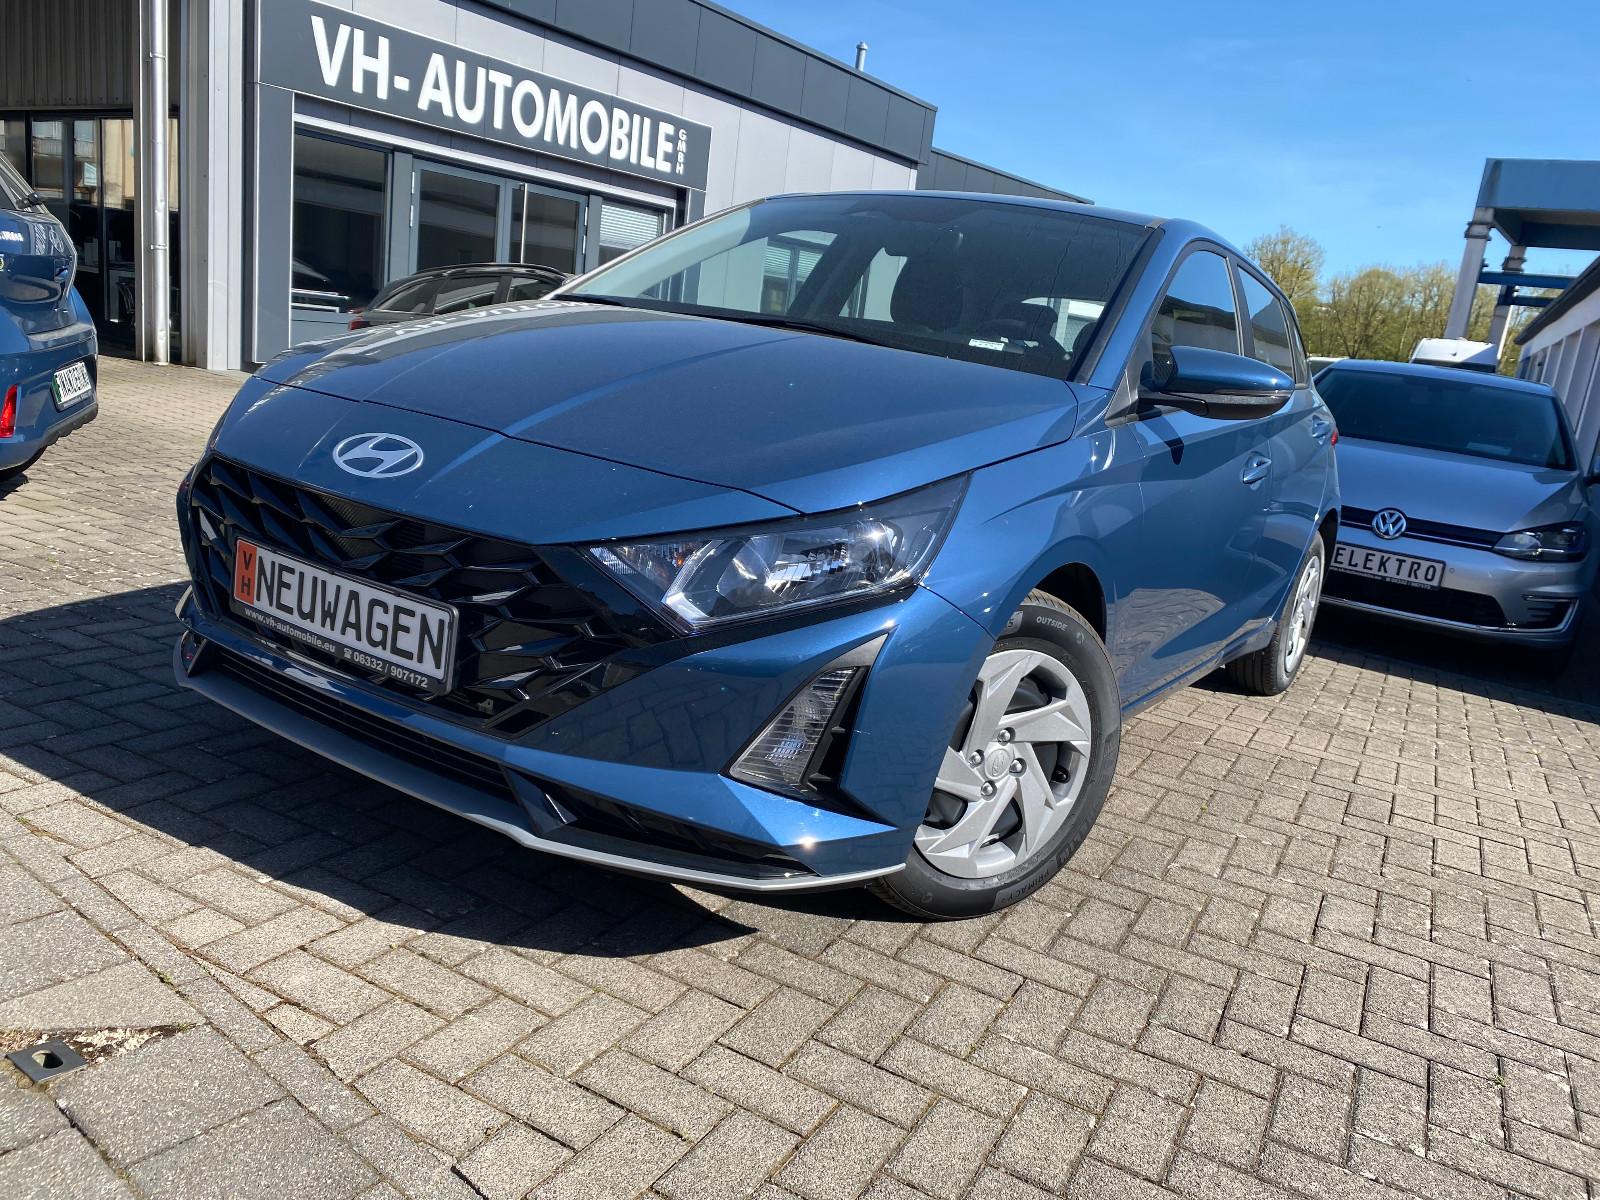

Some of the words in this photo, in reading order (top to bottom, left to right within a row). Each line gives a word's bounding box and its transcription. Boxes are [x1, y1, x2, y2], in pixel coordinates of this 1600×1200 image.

[310, 15, 410, 100] VH-
[417, 52, 675, 174] AUTOMOBILE
[676, 128, 687, 175] GMBH
[1333, 547, 1437, 582] ELEKTRO
[256, 555, 445, 670] NEUWAGEN
[1036, 616, 1068, 631] OUTSIDE
[244, 607, 336, 653] www.vh-automobile.eu
[353, 651, 383, 672] 06332
[390, 665, 428, 688] 907172
